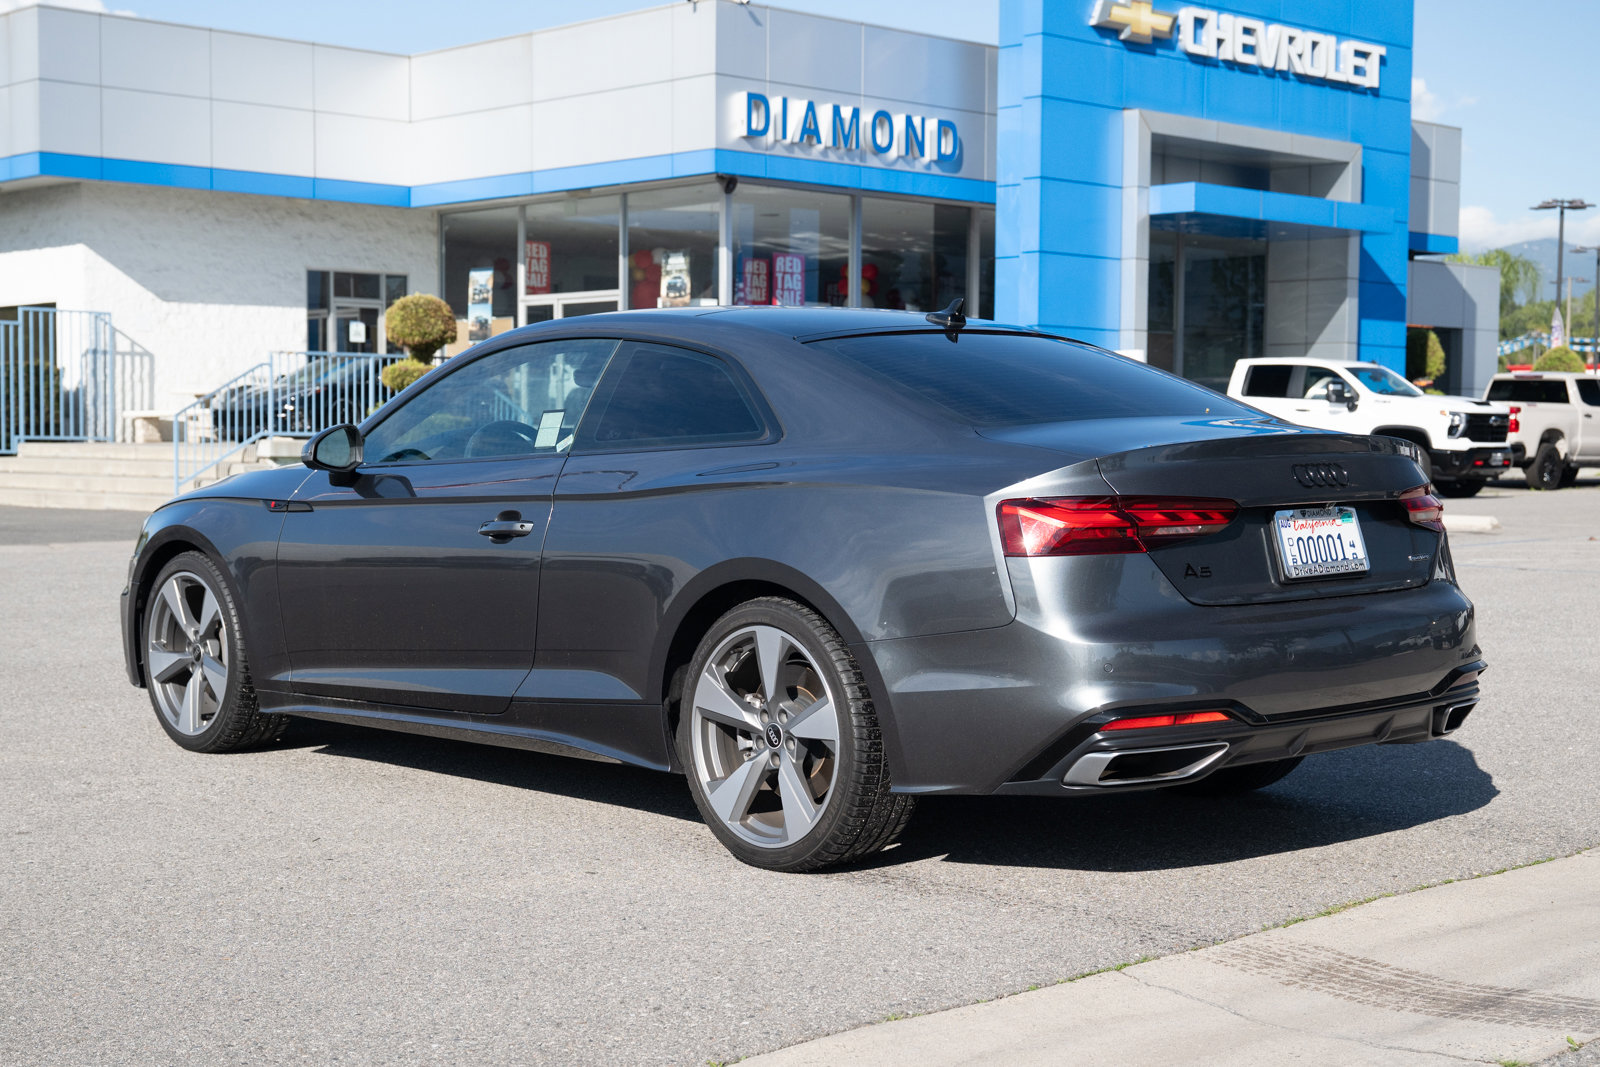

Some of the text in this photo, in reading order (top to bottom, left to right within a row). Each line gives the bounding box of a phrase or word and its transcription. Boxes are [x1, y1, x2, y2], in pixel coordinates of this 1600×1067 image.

[1179, 7, 1386, 89] CHEVROLET
[743, 91, 959, 162] DIAMOND
[745, 260, 767, 274] RED
[775, 256, 802, 273] RED
[745, 274, 767, 288] TAG
[776, 273, 802, 290] TAG
[745, 287, 767, 301] SALE
[776, 289, 802, 305] SALE
[1306, 508, 1332, 517] DIAMOND
[1293, 519, 1342, 534] California
[1297, 533, 1349, 565] 00001
[1184, 563, 1212, 579] A5
[1294, 562, 1366, 577] DriveADiamond.com
